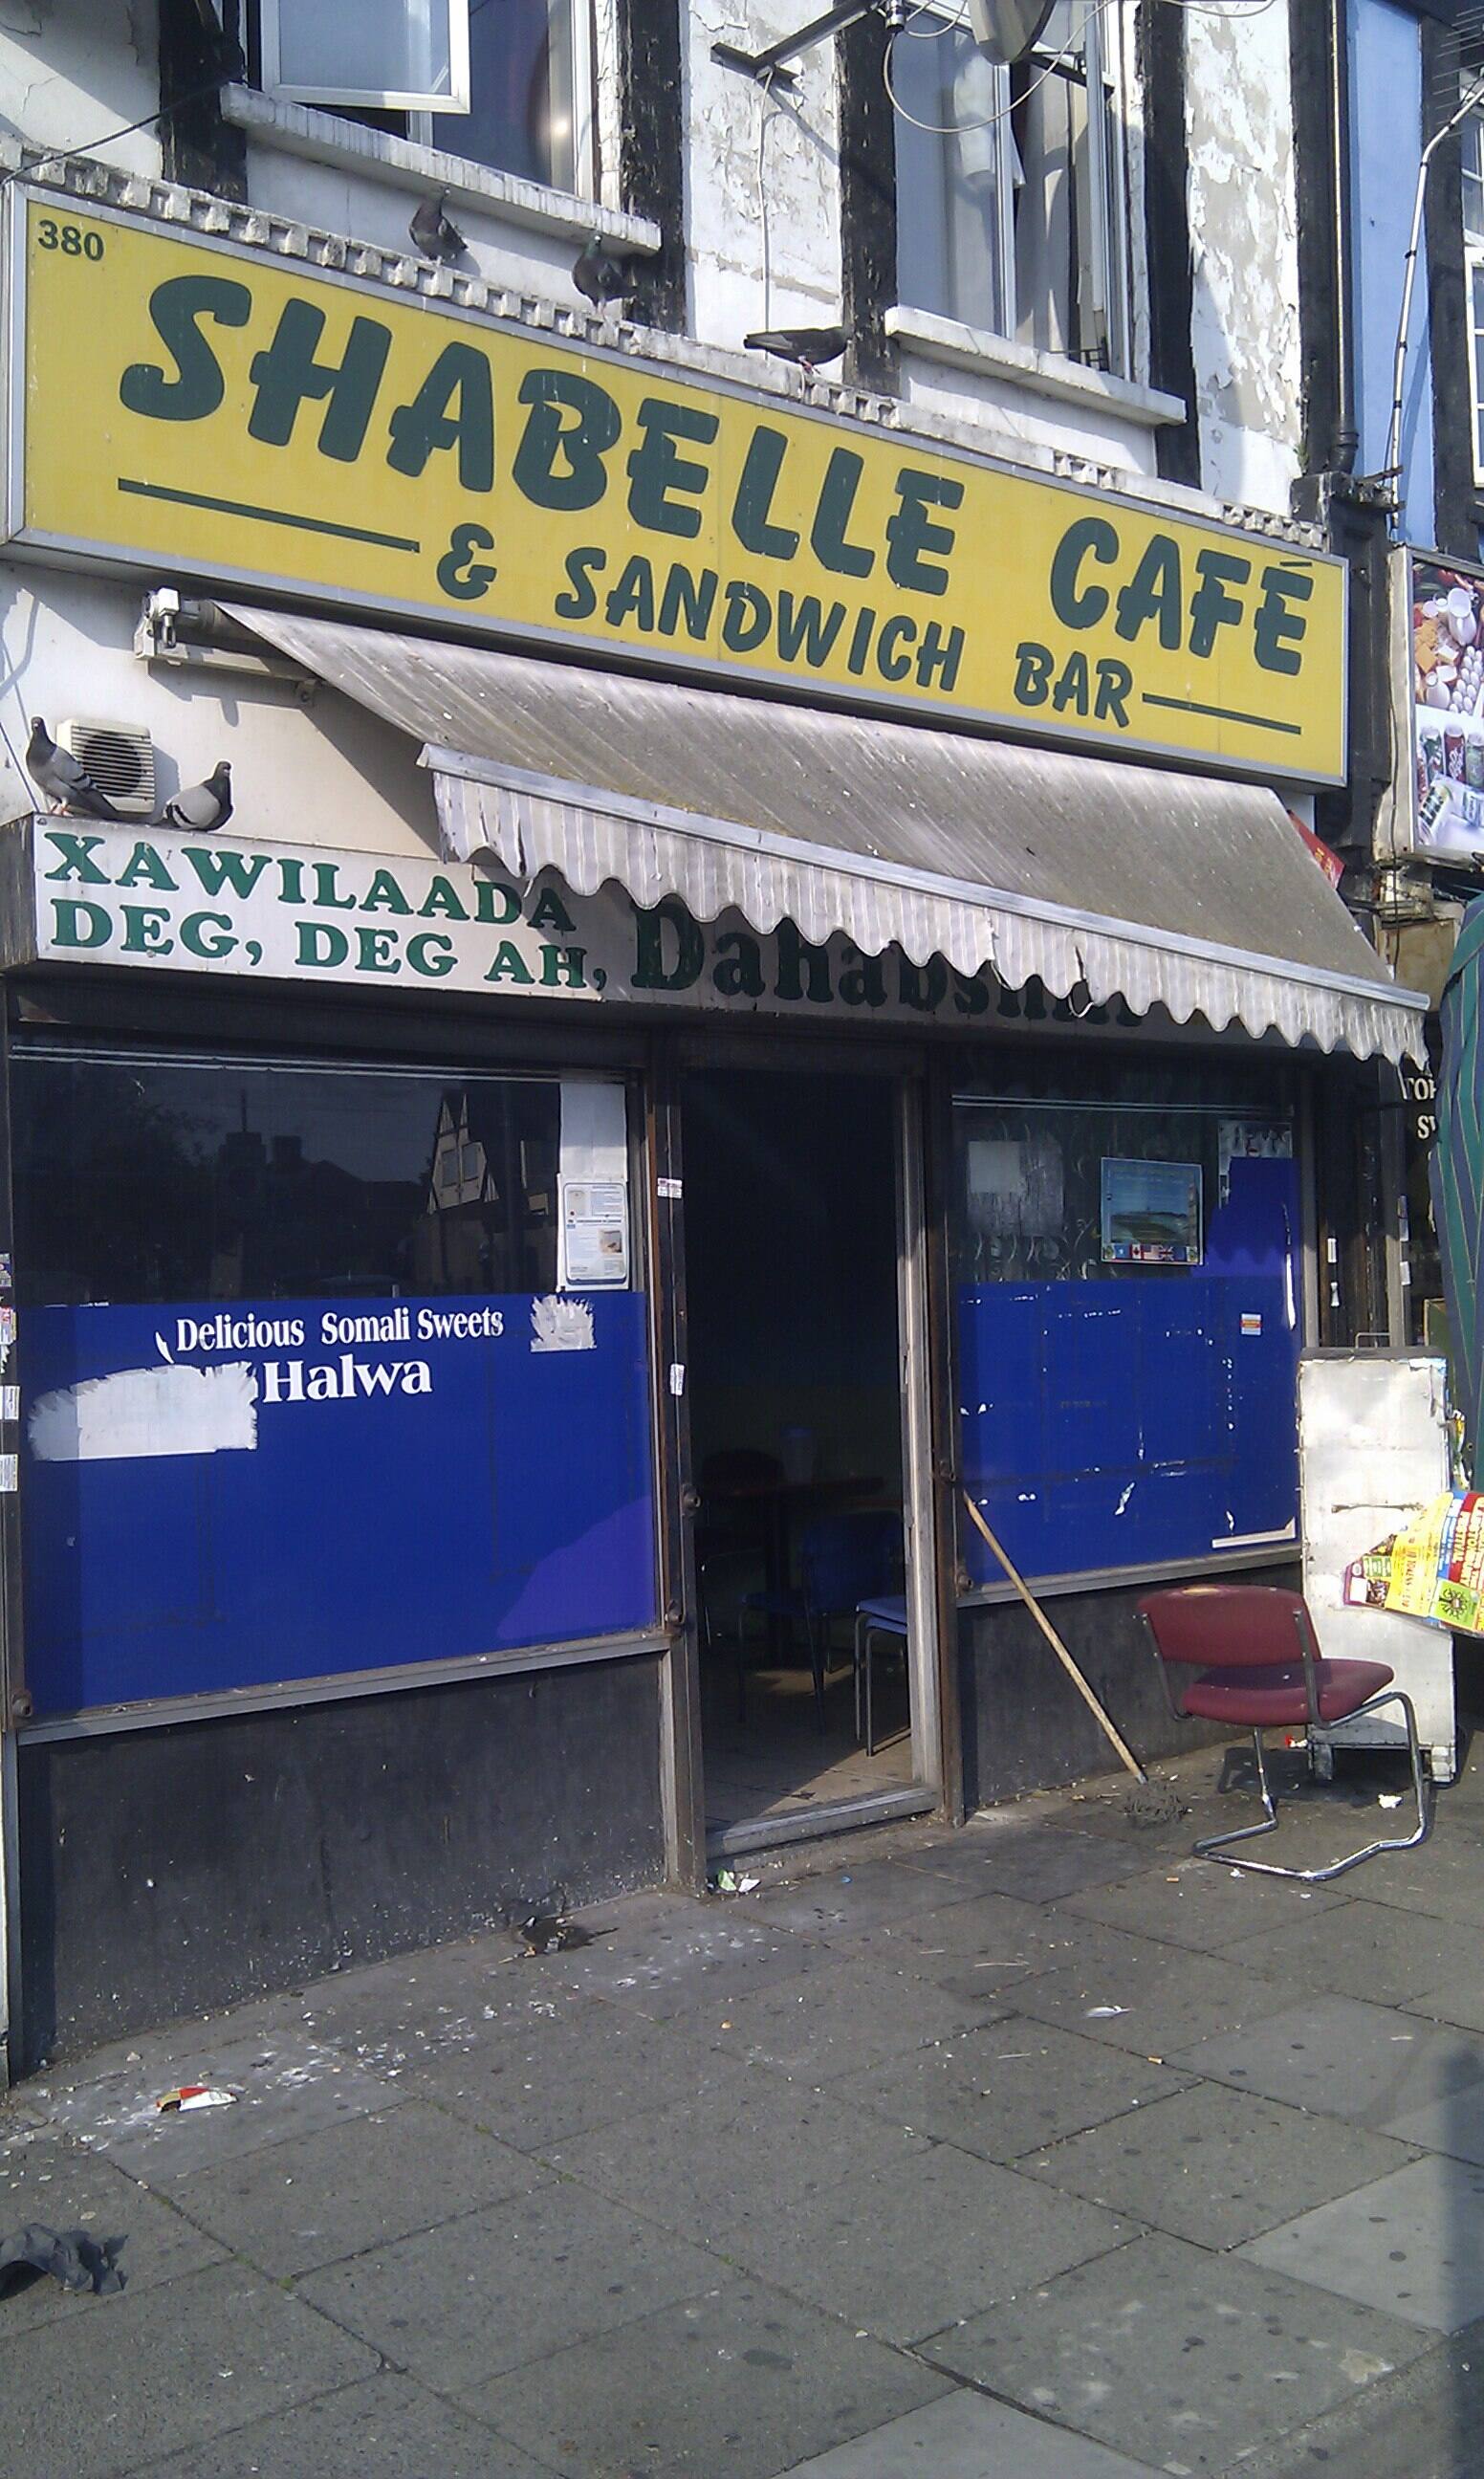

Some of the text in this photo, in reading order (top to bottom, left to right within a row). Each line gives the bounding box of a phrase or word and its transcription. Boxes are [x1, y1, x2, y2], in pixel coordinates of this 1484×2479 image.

[38, 219, 103, 262] 380
[120, 275, 1314, 676] SHABELLE CAFÉ
[436, 523, 1133, 728] & SANDWICH BAR
[45, 832, 577, 933] XAWILAADA
[50, 897, 607, 991] DEG, DEG AH,
[177, 1305, 504, 1352] Delicious Somali Sweets
[262, 1352, 433, 1404] Halwa
